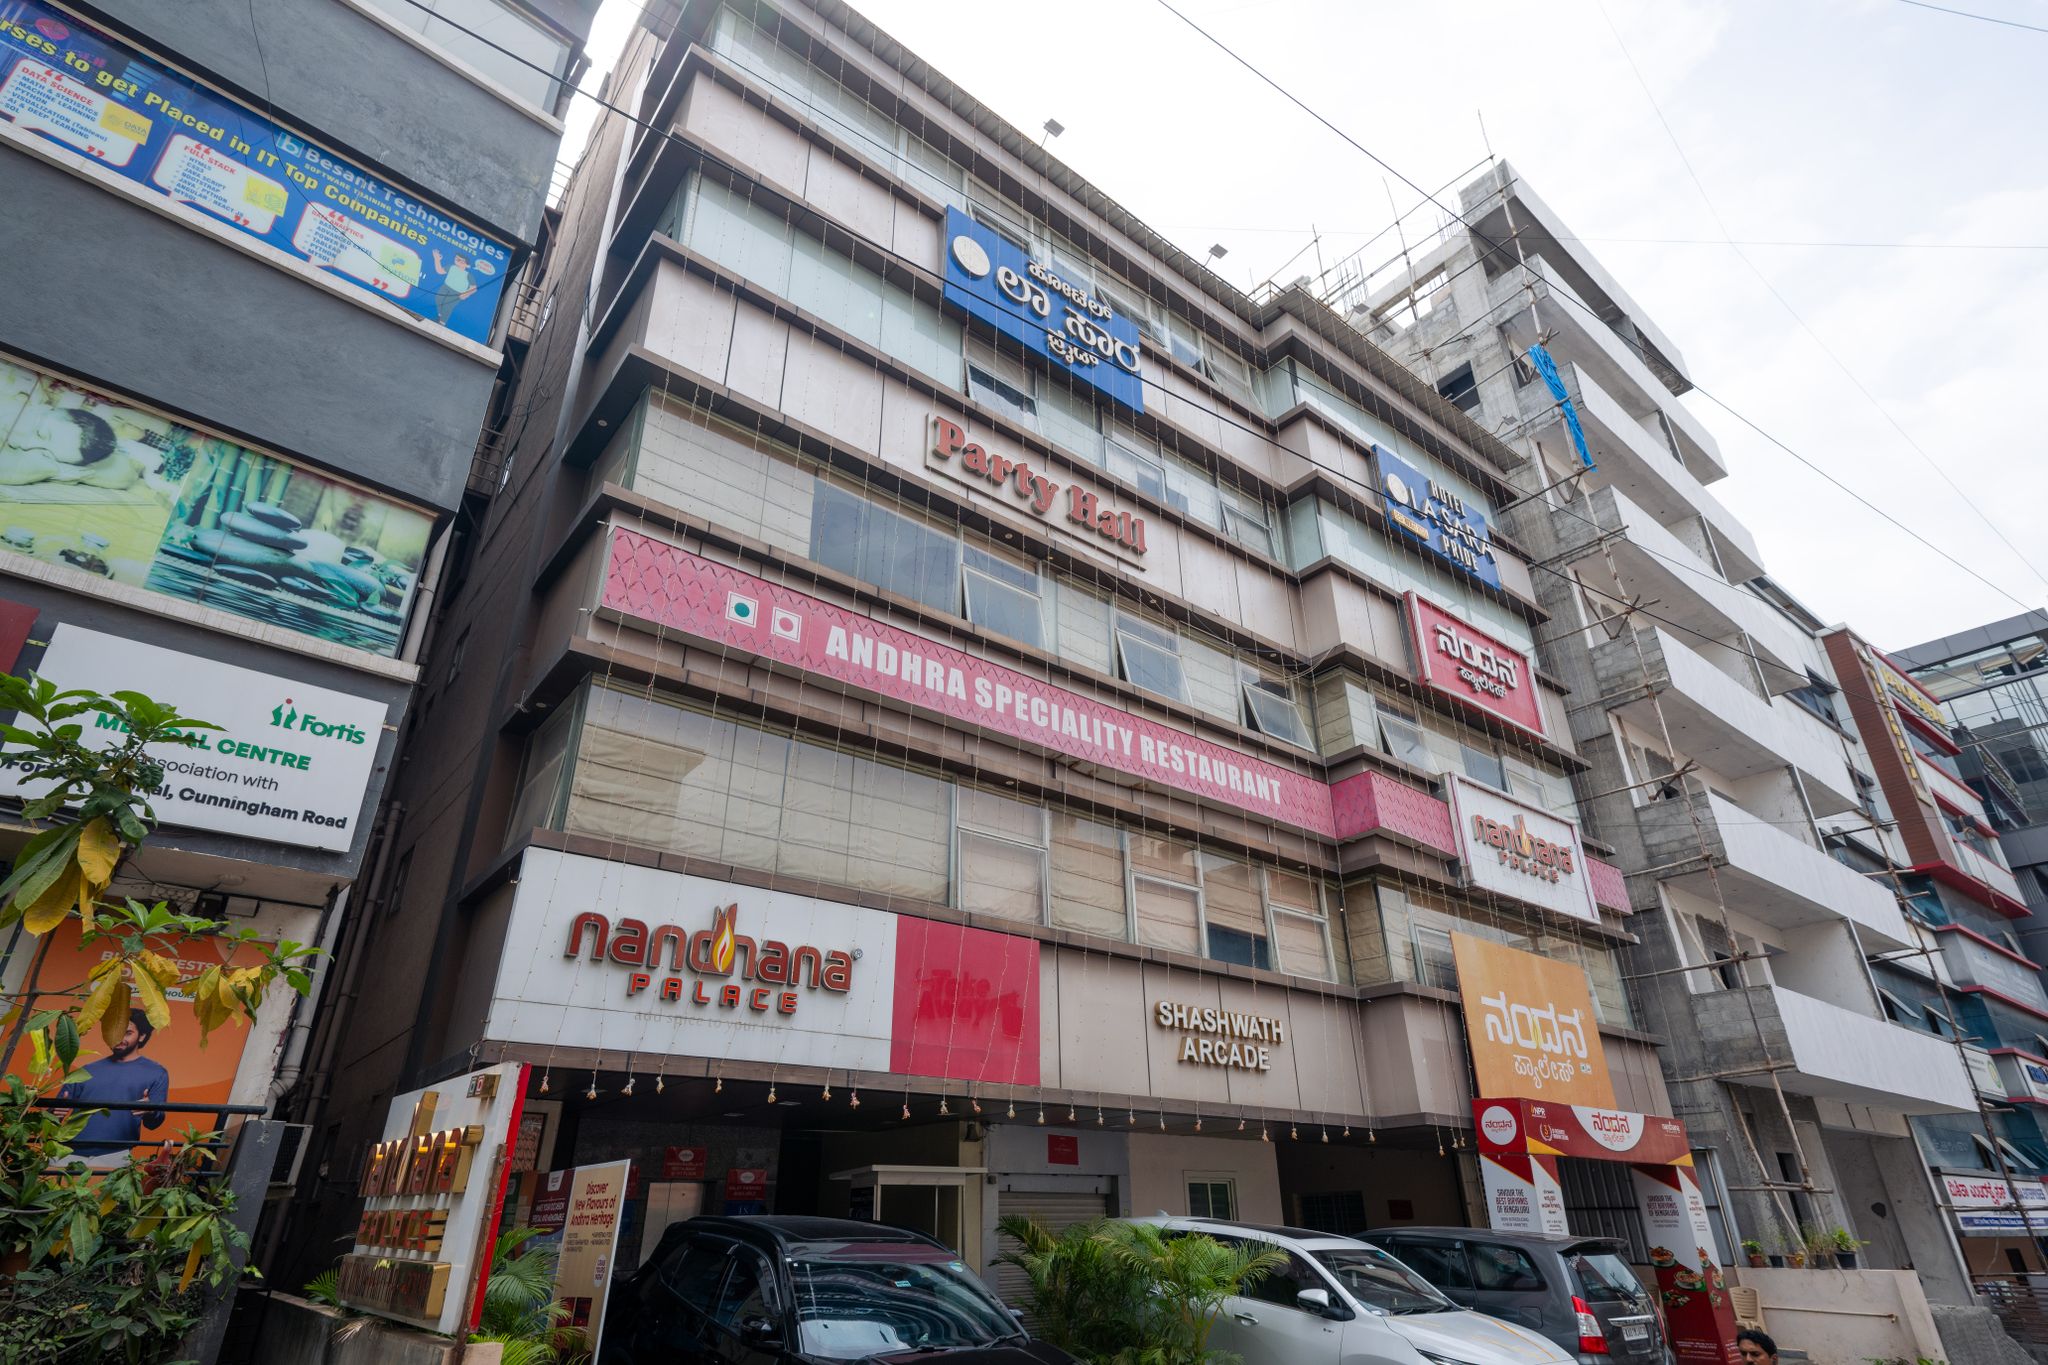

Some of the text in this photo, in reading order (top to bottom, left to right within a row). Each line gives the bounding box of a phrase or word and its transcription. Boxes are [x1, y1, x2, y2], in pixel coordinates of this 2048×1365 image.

[15, 86, 48, 105] PYTHON
[18, 81, 97, 123] MACHINE LEARNING
[21, 66, 94, 106] DATA SCIENCE
[22, 75, 44, 90] MATH
[55, 91, 99, 117] STATISTICS
[12, 92, 72, 124] VISUALIZATION
[27, 106, 49, 120] DEEP
[50, 118, 90, 140] LEARNING
[64, 51, 90, 72] to
[95, 70, 138, 98] get
[143, 91, 225, 142] Placed
[228, 135, 251, 156] in
[256, 150, 280, 171] IT
[285, 162, 319, 190] Top
[324, 184, 428, 246] Companies
[184, 145, 237, 175] FULL STACK
[184, 166, 202, 178] JAVA
[304, 147, 505, 261] Besant Technologies
[304, 163, 350, 191] SOFTWARE
[353, 187, 391, 211] TRAINING
[403, 213, 425, 230] 100%
[427, 226, 477, 257] PLACEMENTS
[310, 243, 337, 259] PYTHON
[314, 231, 339, 246] POWER
[931, 416, 1148, 555] Party Hall
[1428, 480, 1468, 518] HOTEL
[1440, 507, 1496, 563] SARA
[1440, 534, 1479, 572] PRIDE
[1434, 623, 1518, 689] ನಂದನ
[300, 713, 366, 745] Fortis
[825, 625, 1281, 805] ANDHRA SPECIALITY RESTAURANT
[218, 738, 311, 771] CENTRE
[242, 770, 280, 792] with
[178, 787, 299, 821] Cunningham
[302, 809, 348, 830] Road
[1471, 814, 1575, 875] nandhana
[1497, 850, 1560, 884] PALACE
[563, 903, 854, 993] nandhana
[626, 972, 798, 1015] PALACE
[1155, 1000, 1285, 1043] SHASHWATH
[1480, 990, 1588, 1059] ನಂದನ
[1178, 1036, 1271, 1071] ARCADE
[1591, 1111, 1631, 1134] ನಂದನ
[586, 1181, 609, 1196] Discover
